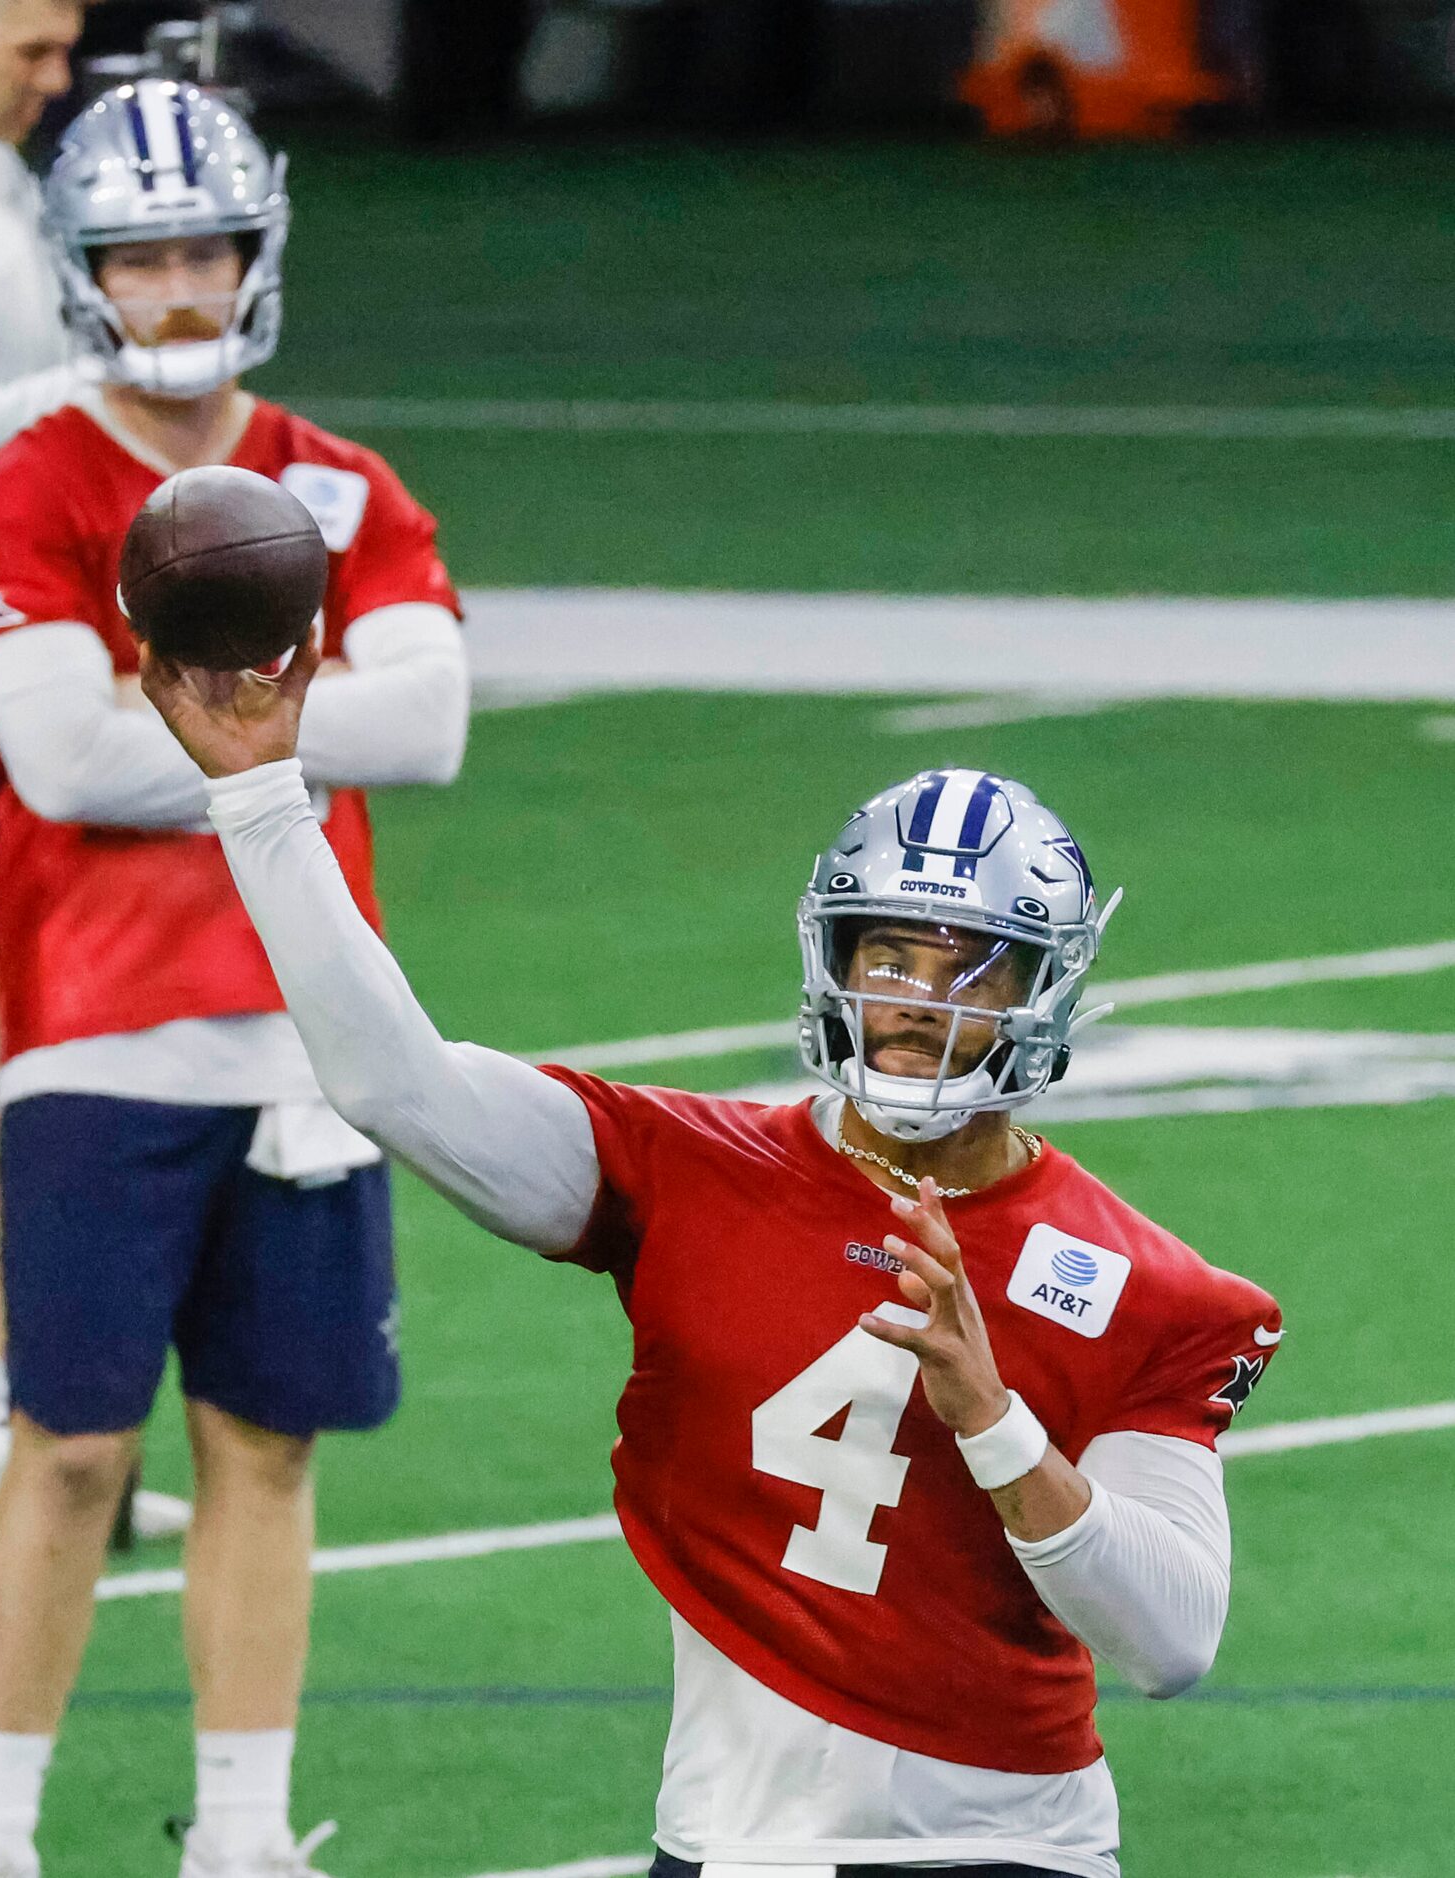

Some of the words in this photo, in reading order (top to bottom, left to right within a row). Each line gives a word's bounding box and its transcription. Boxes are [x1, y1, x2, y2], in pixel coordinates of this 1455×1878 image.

[900, 879, 967, 899] COWBOYS
[844, 1241, 905, 1275] COWB
[1030, 1283, 1093, 1318] AT&T
[751, 1300, 930, 1596] 4
